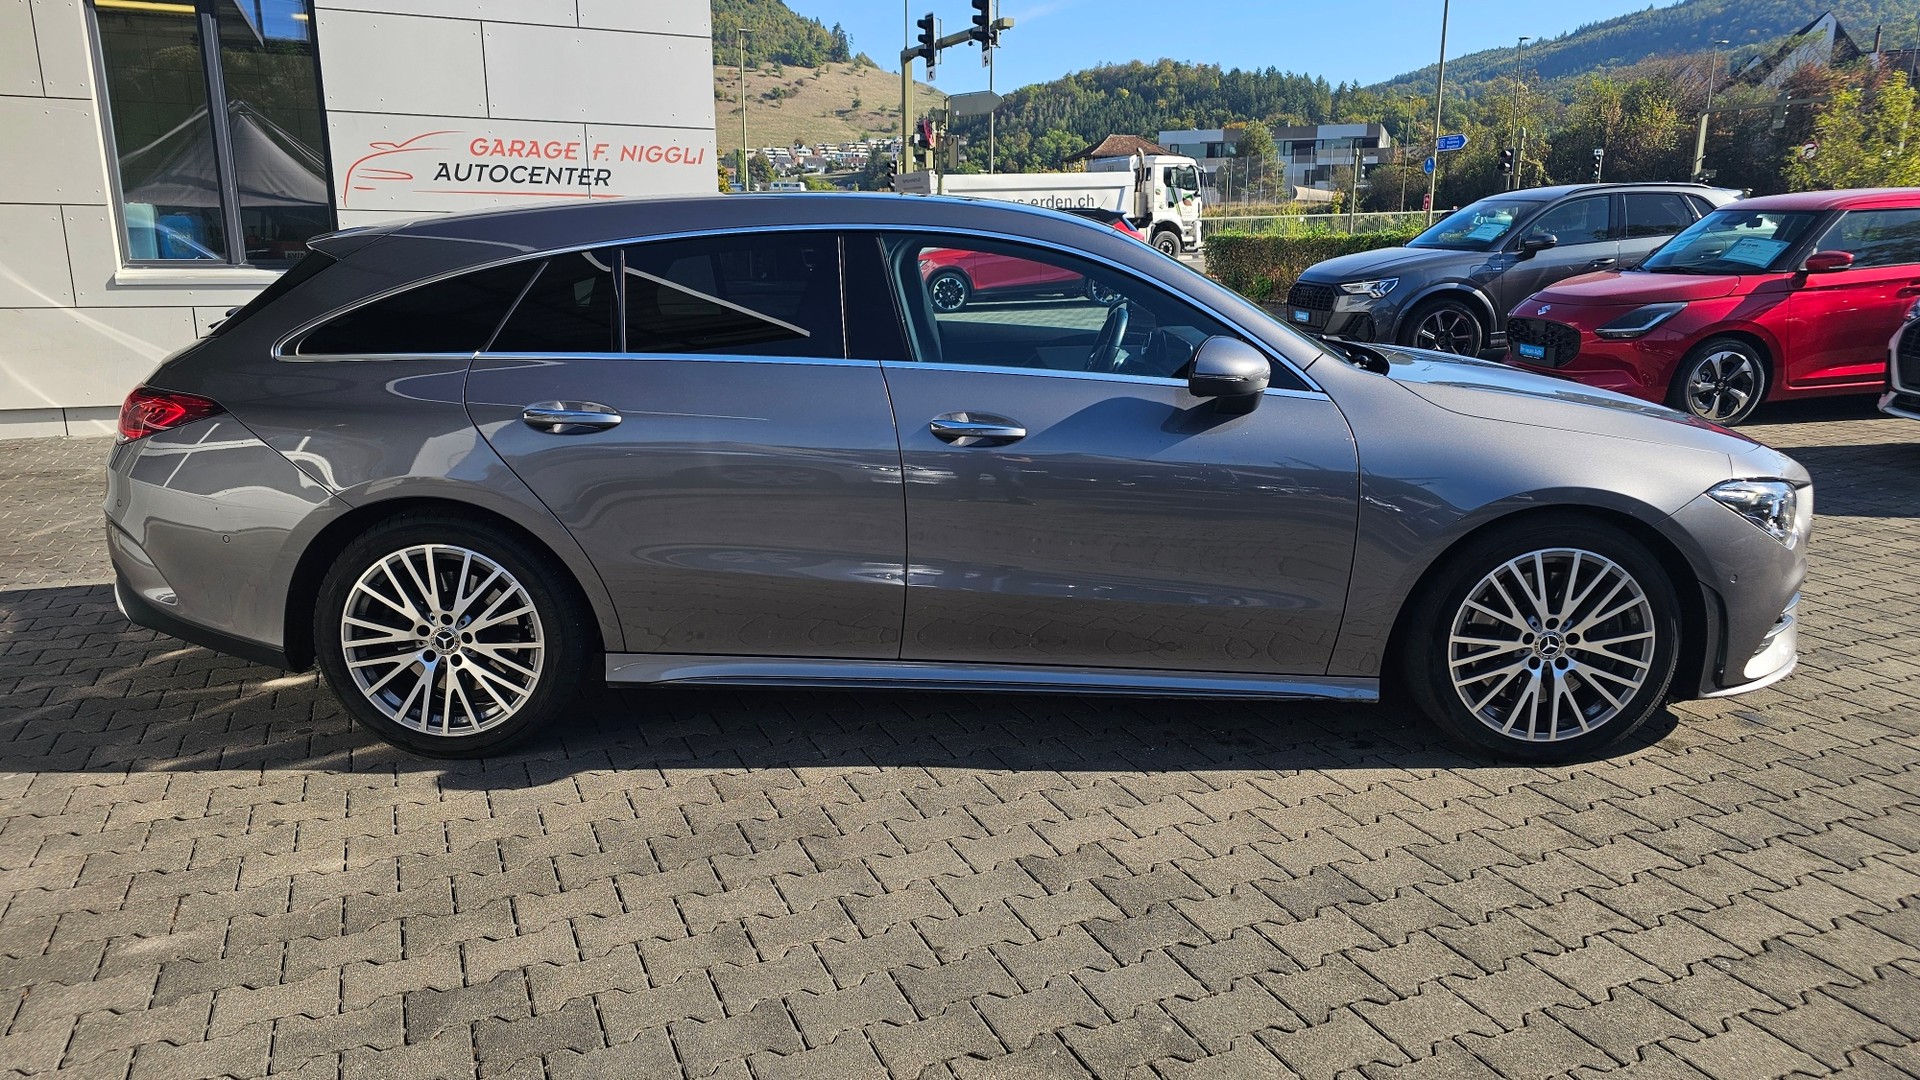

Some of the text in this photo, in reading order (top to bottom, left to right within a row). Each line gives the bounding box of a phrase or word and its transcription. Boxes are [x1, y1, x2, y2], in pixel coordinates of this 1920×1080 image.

[469, 137, 704, 165] GARAGE F. NIGGLI
[433, 162, 612, 187] AUTOCENTER
